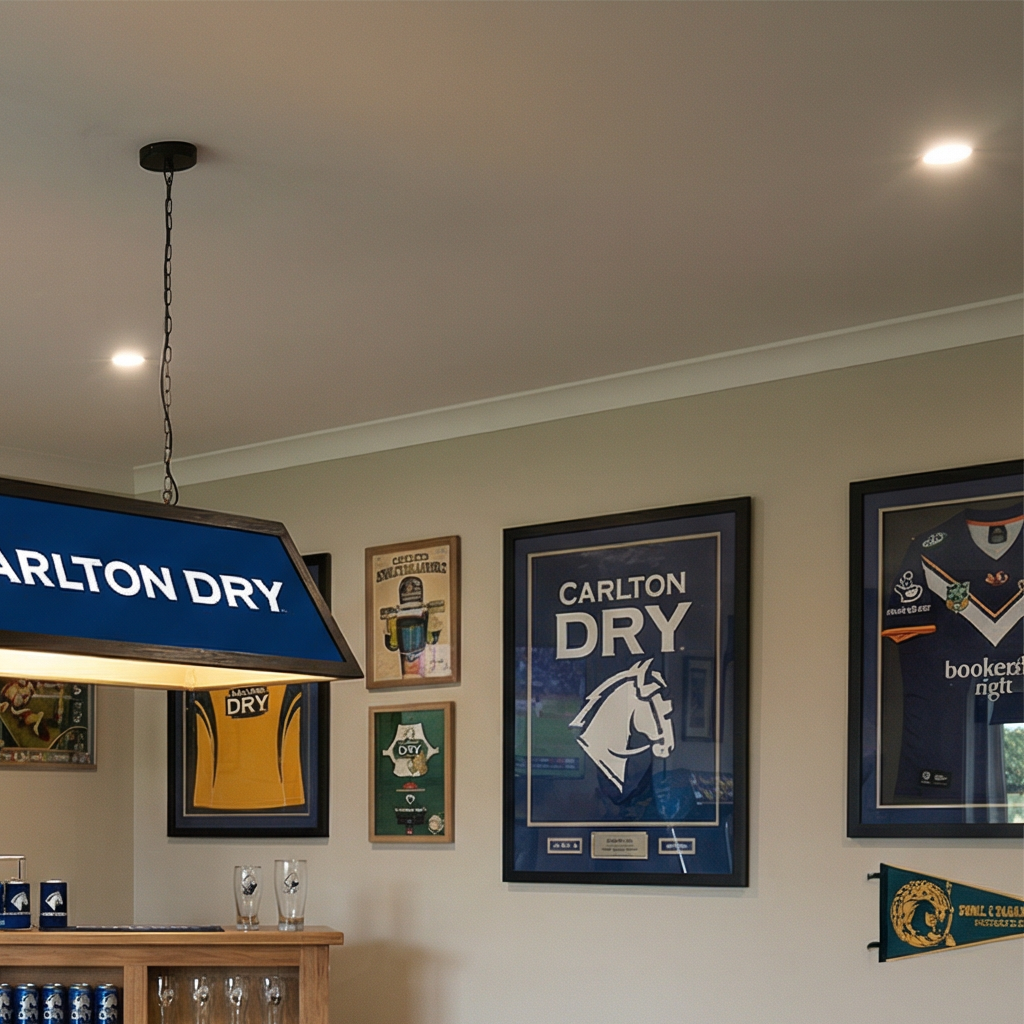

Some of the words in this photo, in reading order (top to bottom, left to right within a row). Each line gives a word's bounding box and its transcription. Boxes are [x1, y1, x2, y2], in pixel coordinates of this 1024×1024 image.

[183, 569, 283, 613] DRY
[559, 571, 686, 606] CARLTON
[555, 601, 693, 660] DRY
[227, 694, 269, 715] DRY
